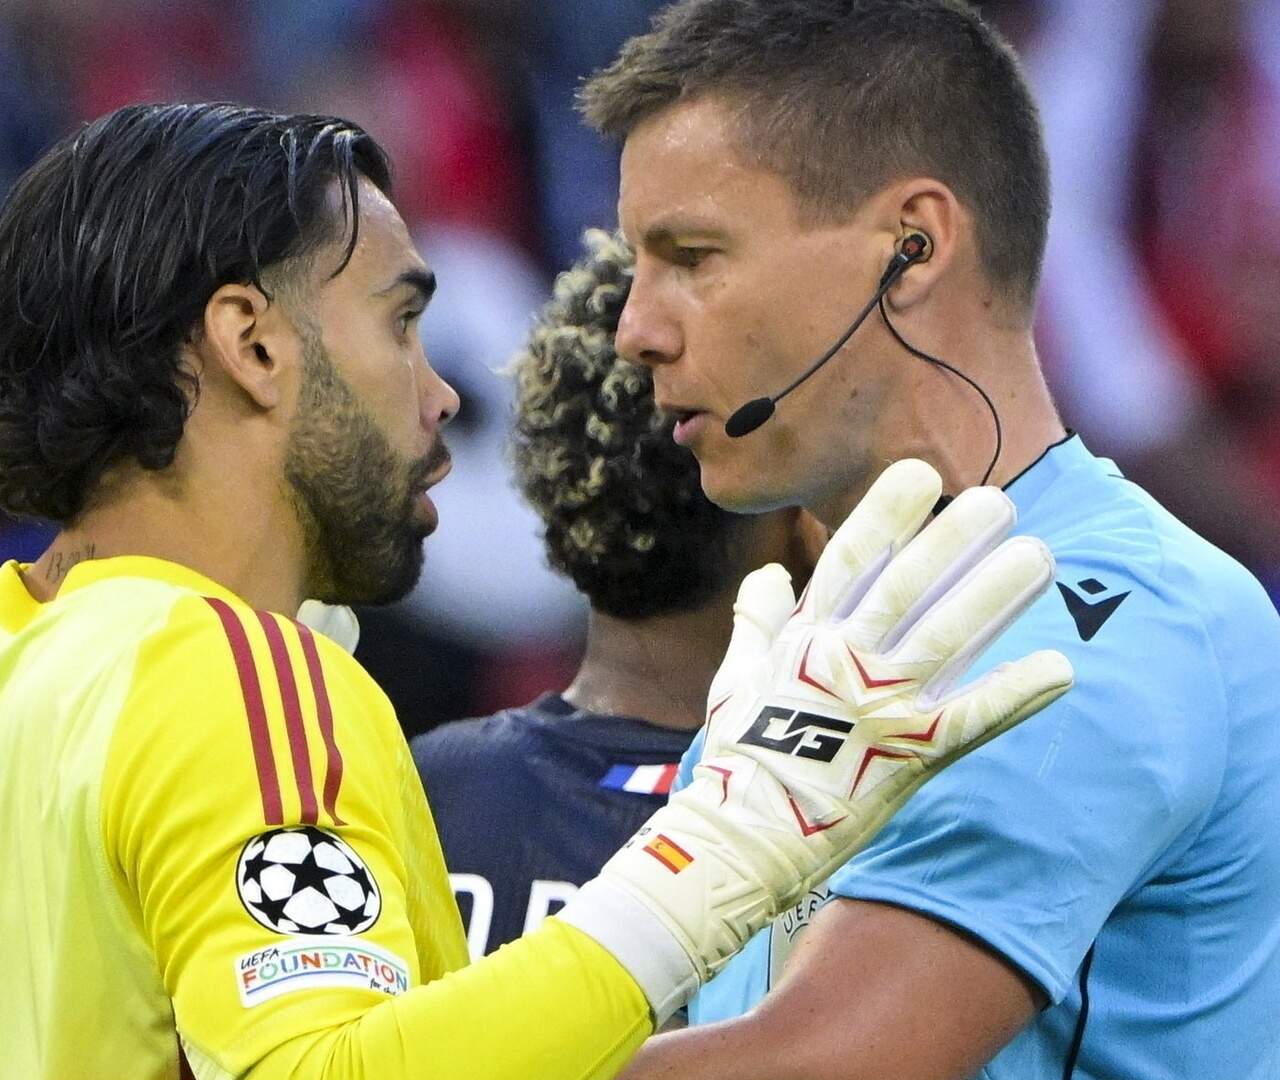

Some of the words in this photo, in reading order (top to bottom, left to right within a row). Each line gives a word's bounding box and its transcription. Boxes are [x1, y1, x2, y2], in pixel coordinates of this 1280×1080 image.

[783, 899, 818, 934] UEF
[240, 948, 280, 970] UEFA
[242, 952, 408, 993] FOUNDATION
